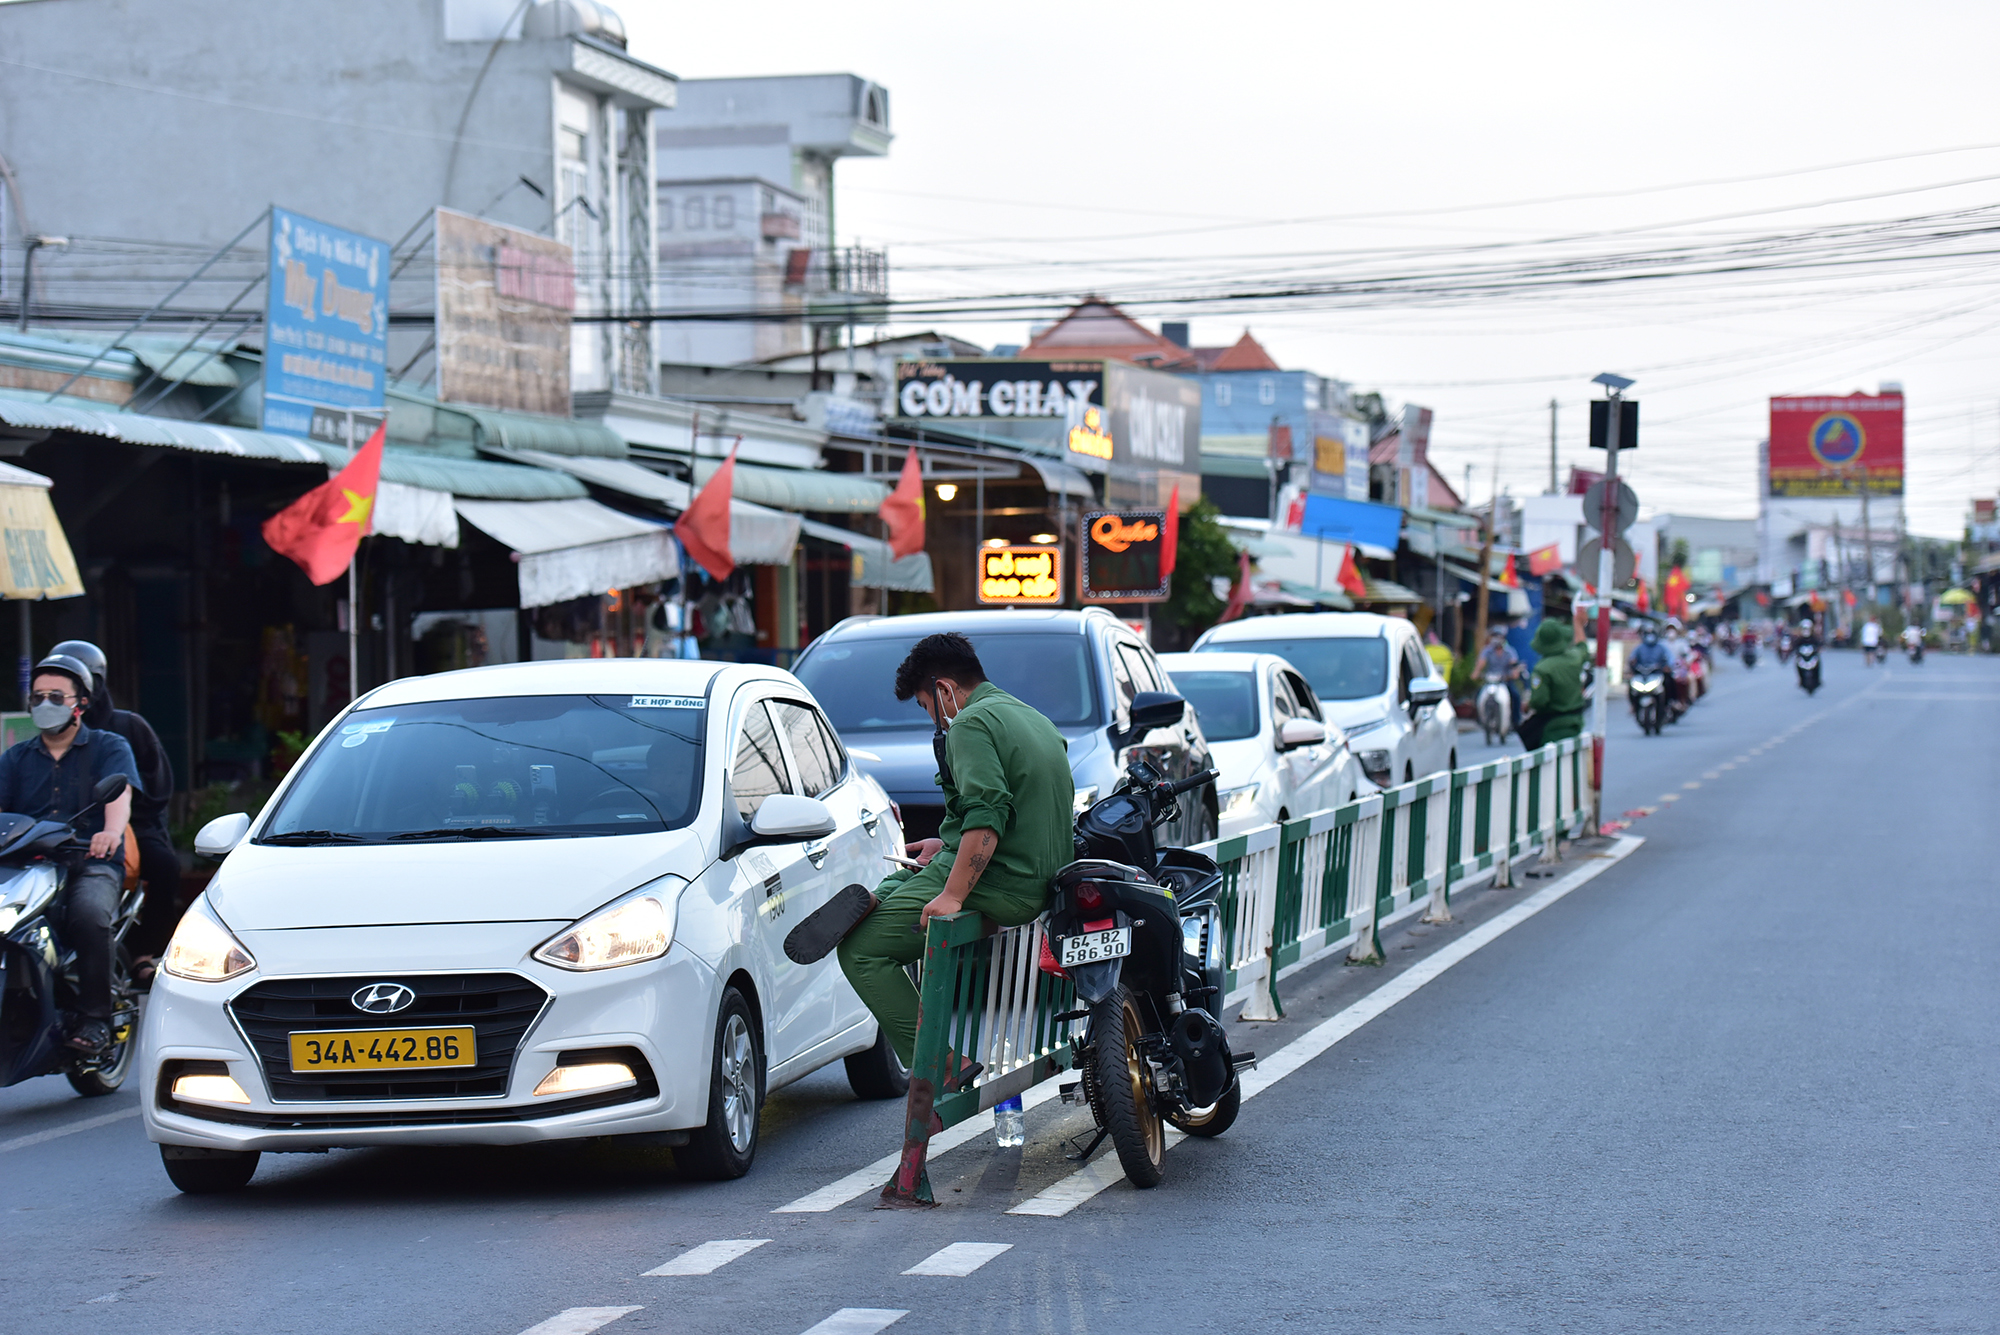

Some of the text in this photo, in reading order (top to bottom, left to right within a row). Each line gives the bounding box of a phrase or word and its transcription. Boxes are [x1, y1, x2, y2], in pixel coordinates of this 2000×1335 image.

[900, 373, 983, 418] CƠM
[988, 379, 1098, 418] CHAY
[650, 698, 672, 707] HỢP
[674, 698, 704, 707] ĐỒNG
[1071, 930, 1121, 950] 64-B2
[1066, 942, 1125, 964] 586.90
[306, 1035, 460, 1065] 34A-442.86
